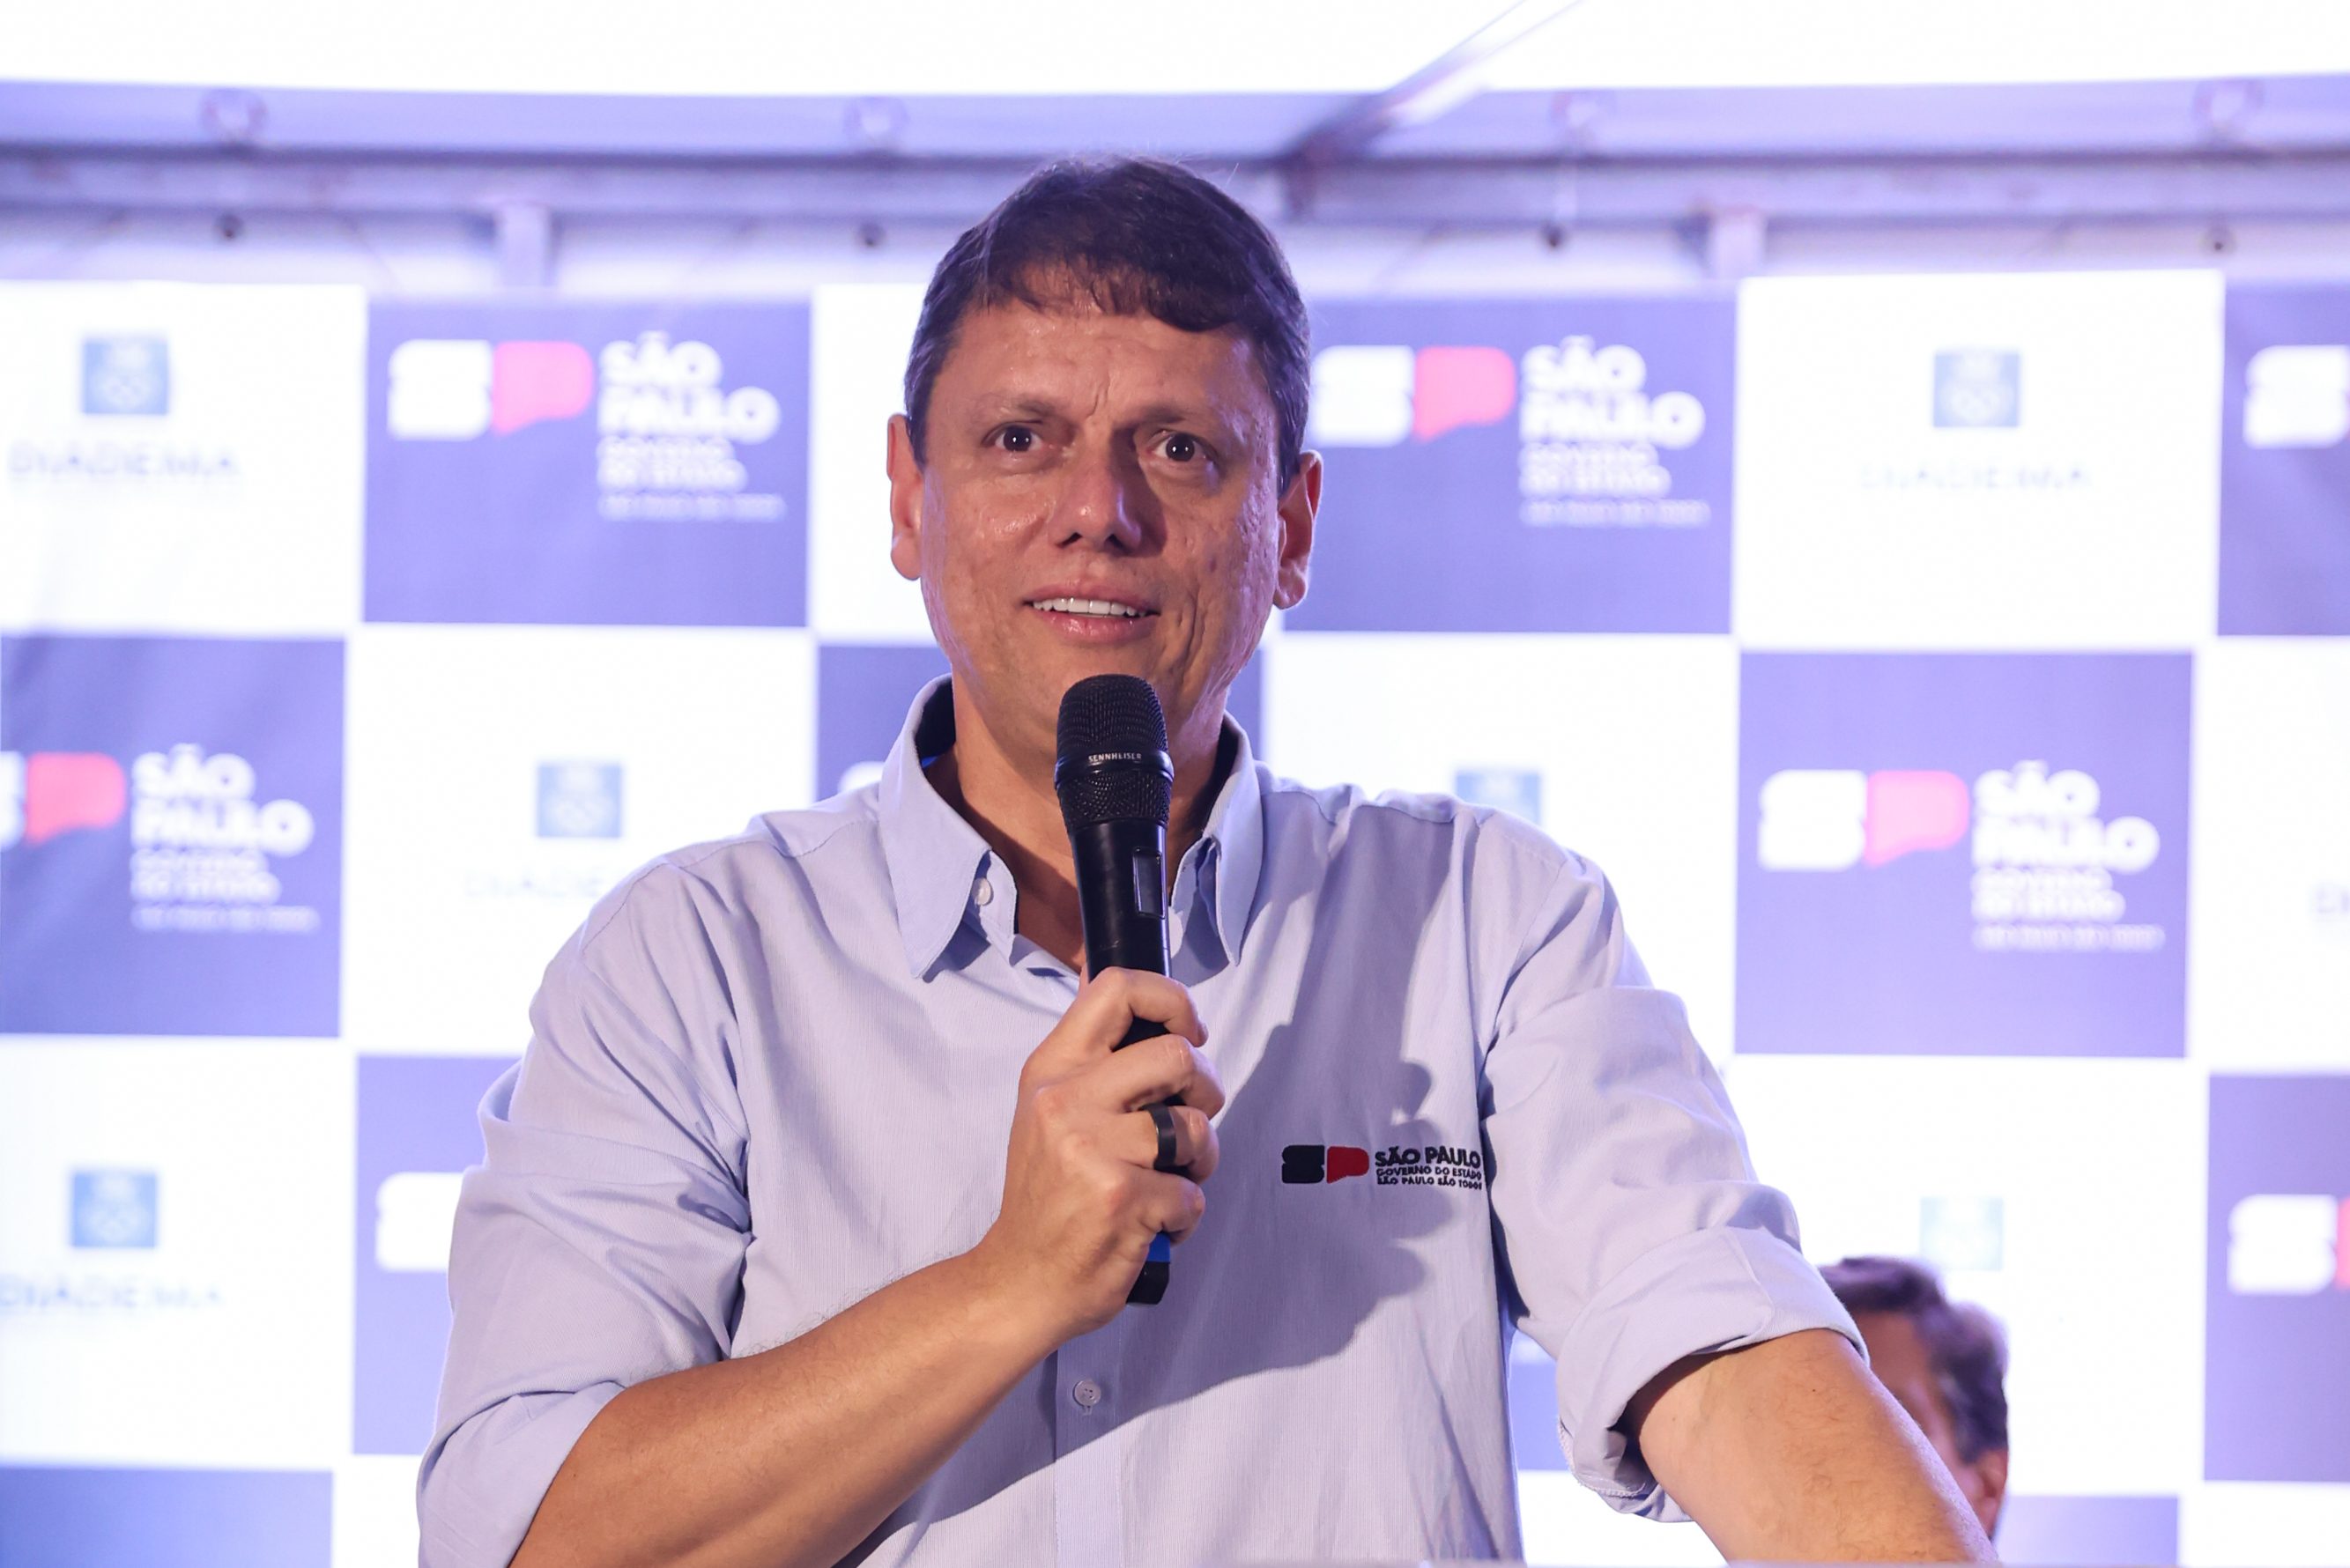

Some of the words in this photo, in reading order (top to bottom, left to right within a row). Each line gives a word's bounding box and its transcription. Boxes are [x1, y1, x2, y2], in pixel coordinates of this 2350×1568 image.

[1375, 1146, 1420, 1166] SÃO
[1425, 1146, 1480, 1169] PAULO
[1376, 1165, 1432, 1176] GOVERNO
[1434, 1166, 1449, 1175] DO
[1452, 1168, 1481, 1180] ESTADO
[1377, 1176, 1398, 1185] SÃO
[1437, 1176, 1456, 1187] SÃO
[1458, 1180, 1482, 1190] TODOS
